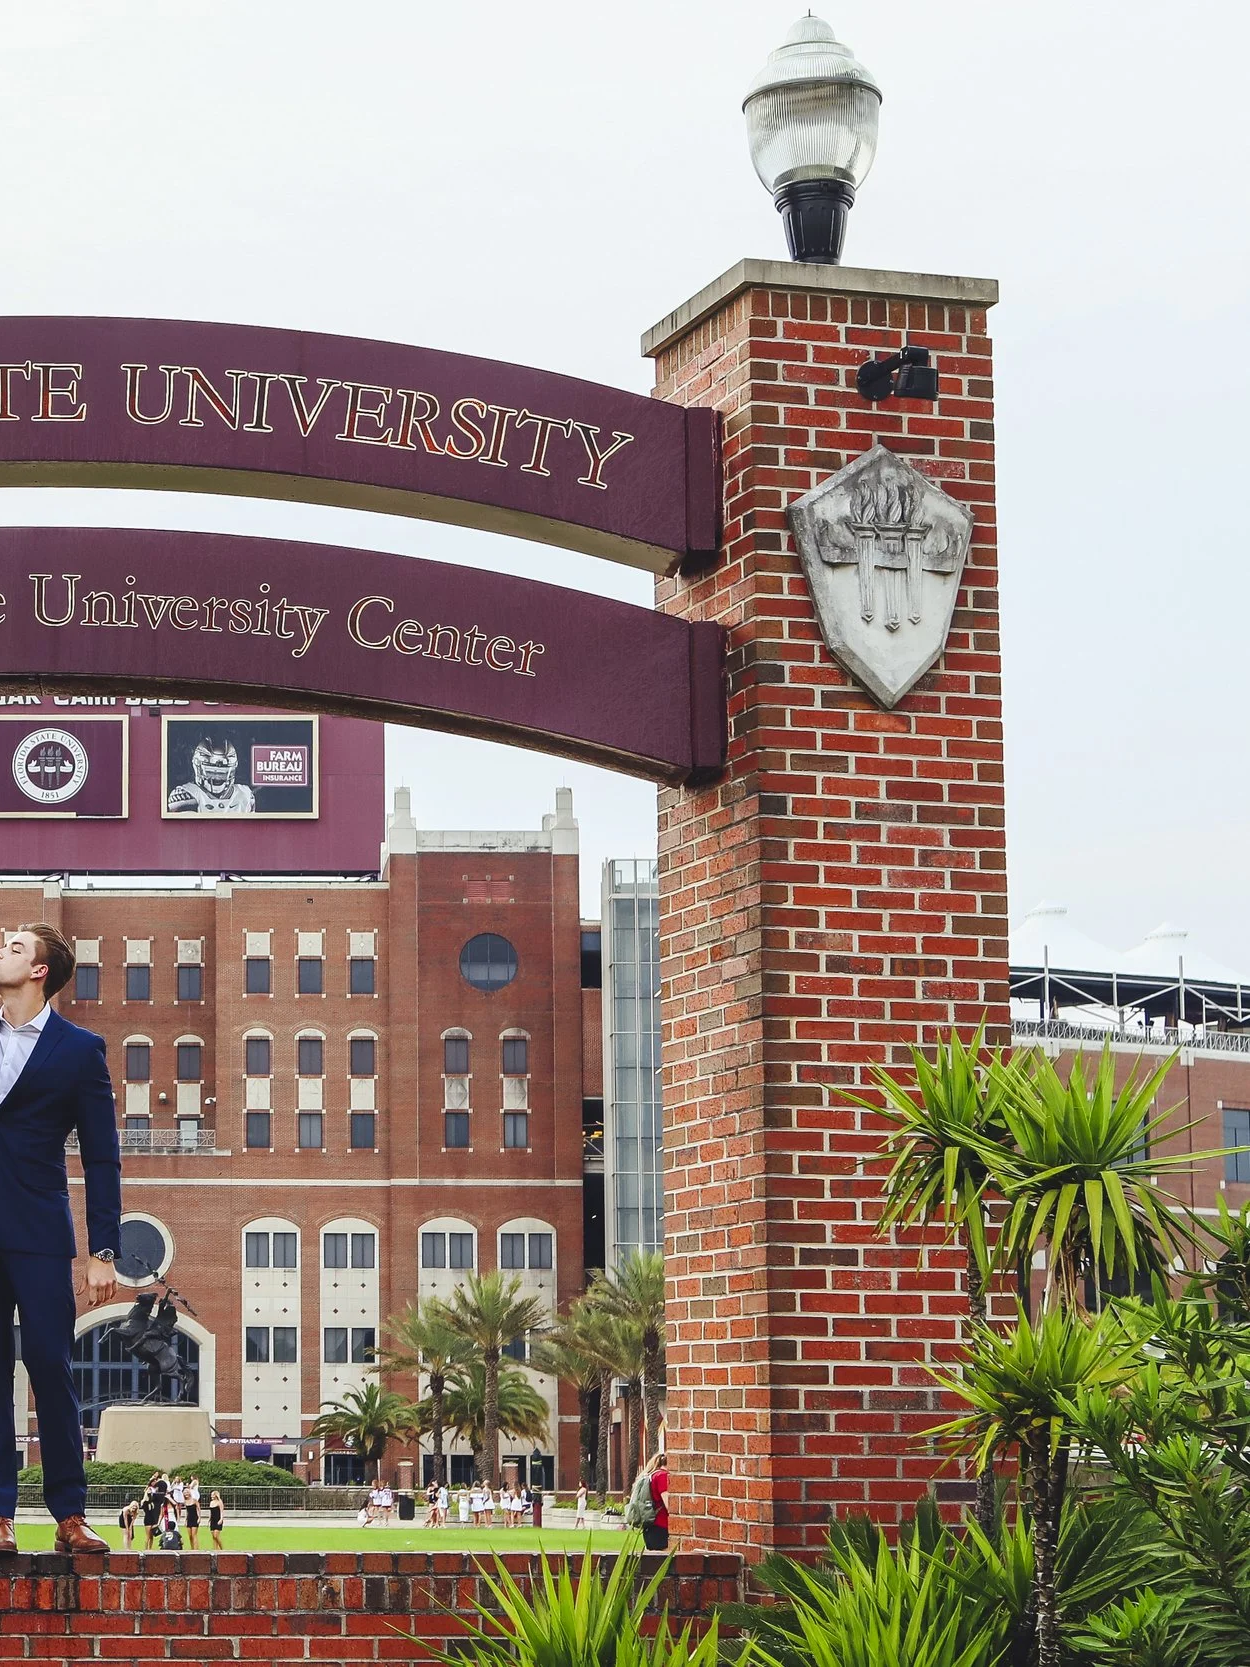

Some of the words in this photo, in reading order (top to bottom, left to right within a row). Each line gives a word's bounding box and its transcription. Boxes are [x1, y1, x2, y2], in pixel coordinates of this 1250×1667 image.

[120, 363, 635, 491] UNIVERSITY
[28, 573, 330, 658] University
[347, 595, 547, 677] Center
[29, 732, 57, 746] STATE
[60, 735, 84, 786] UNIVERSITY
[269, 750, 303, 761] FARM
[256, 761, 303, 772] BUREAU
[262, 774, 303, 782] INSURANCE
[41, 791, 60, 799] 1851
